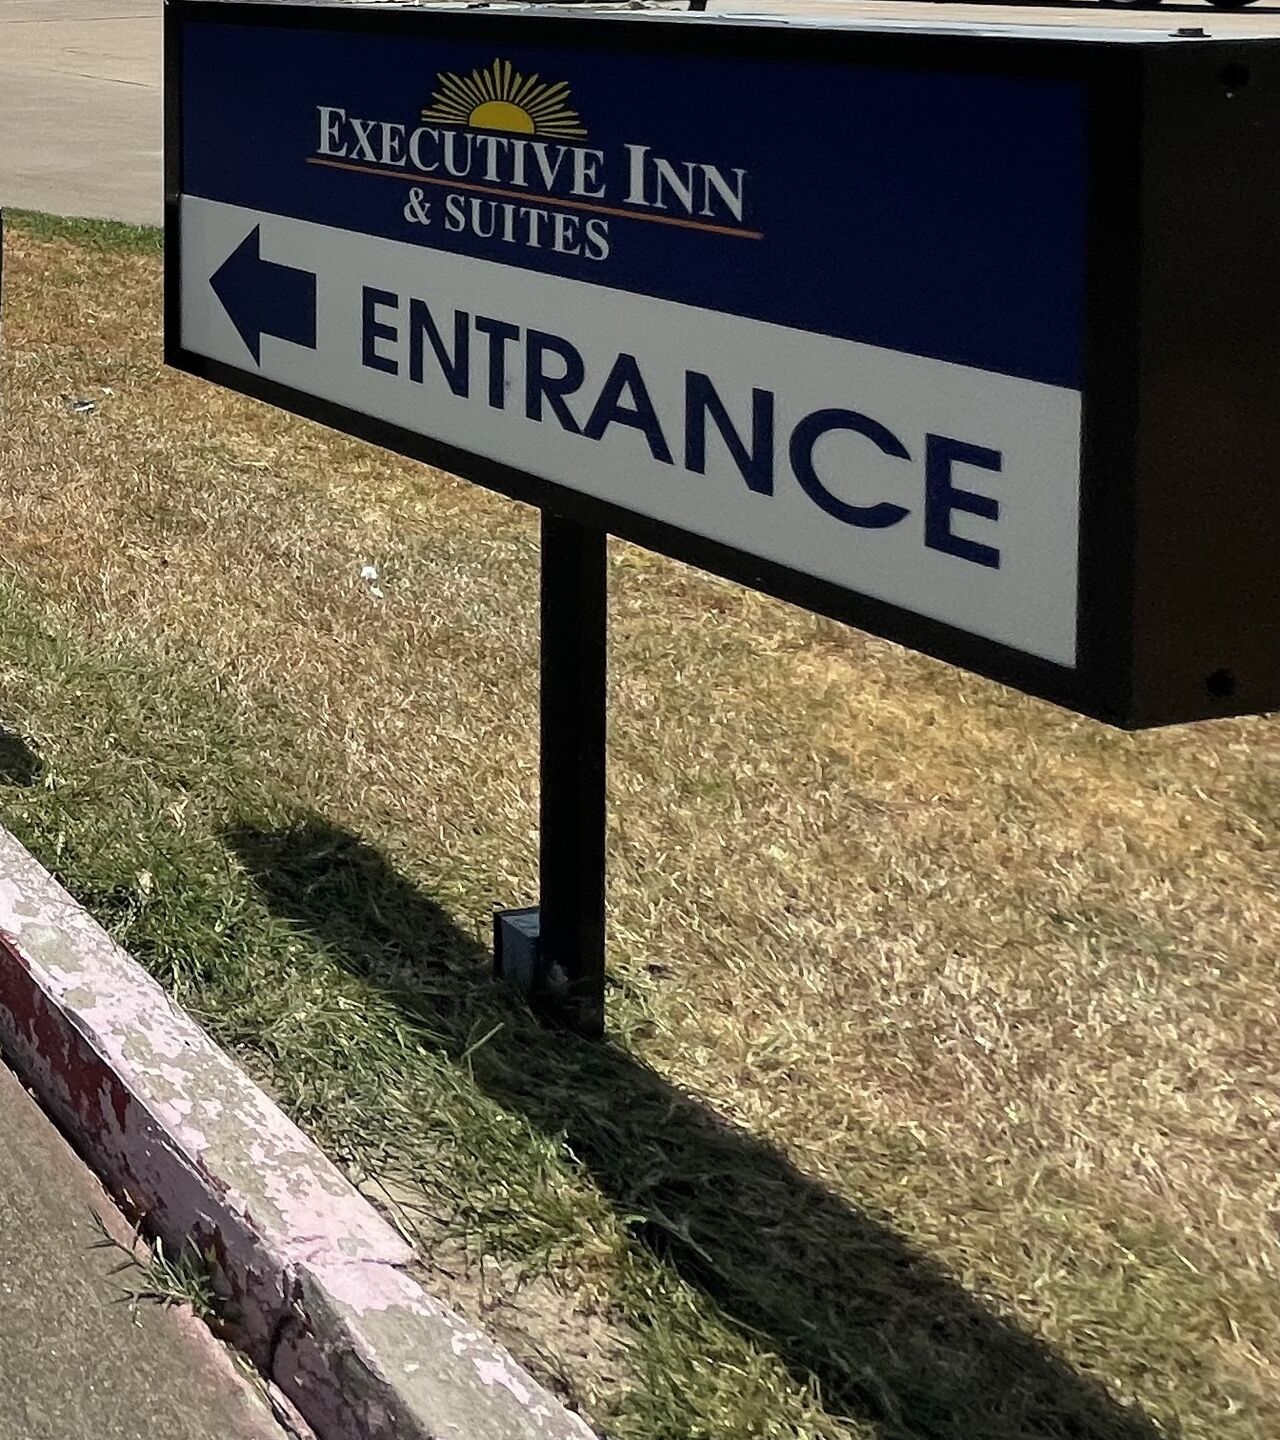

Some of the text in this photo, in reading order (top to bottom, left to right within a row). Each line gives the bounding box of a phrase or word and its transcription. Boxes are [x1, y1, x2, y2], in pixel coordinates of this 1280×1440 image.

[316, 106, 748, 222] EXECUTIVE INN
[403, 187, 610, 261] & SUITES
[360, 286, 1003, 570] ENTRANCE
